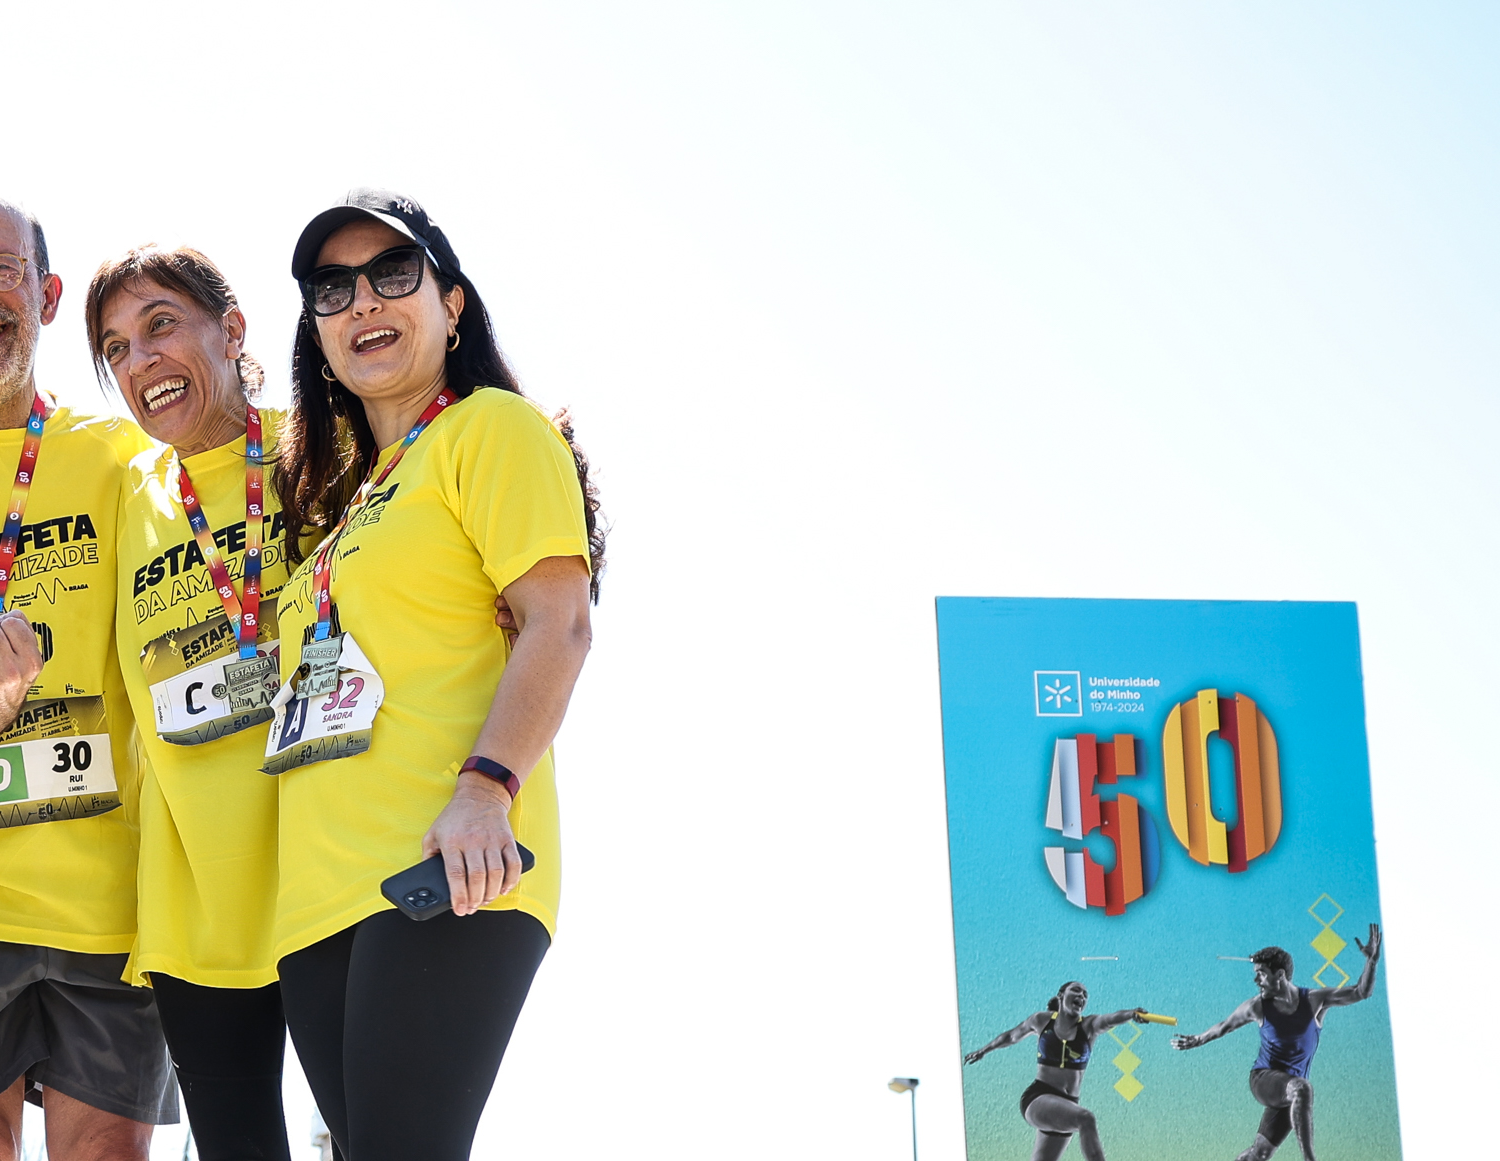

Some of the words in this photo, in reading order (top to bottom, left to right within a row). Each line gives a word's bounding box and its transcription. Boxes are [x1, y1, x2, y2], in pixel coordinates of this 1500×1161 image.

[19, 472, 29, 483] 50
[249, 504, 261, 515] 50
[219, 586, 232, 598] 50
[134, 591, 166, 625] DA
[244, 613, 256, 626] 50
[186, 659, 194, 668] DA
[195, 642, 224, 661] AMIZADE
[304, 650, 337, 658] FINISHER
[230, 659, 270, 680] ESTAFETA
[1089, 676, 1160, 688] Universidade
[186, 682, 206, 715] C
[216, 686, 226, 696] 50
[321, 677, 365, 711] 32
[1090, 690, 1105, 700] do
[1108, 690, 1141, 700] Minho
[1091, 702, 1145, 714] 1974-2024
[234, 714, 249, 730] 50
[286, 700, 302, 738] A
[322, 711, 353, 723] SANDRA
[6, 725, 36, 741] AMIZADE
[52, 740, 92, 773] 30
[300, 745, 312, 762] 50
[70, 775, 83, 783] RUI
[1044, 689, 1283, 916] 50
[38, 803, 52, 819] 50
